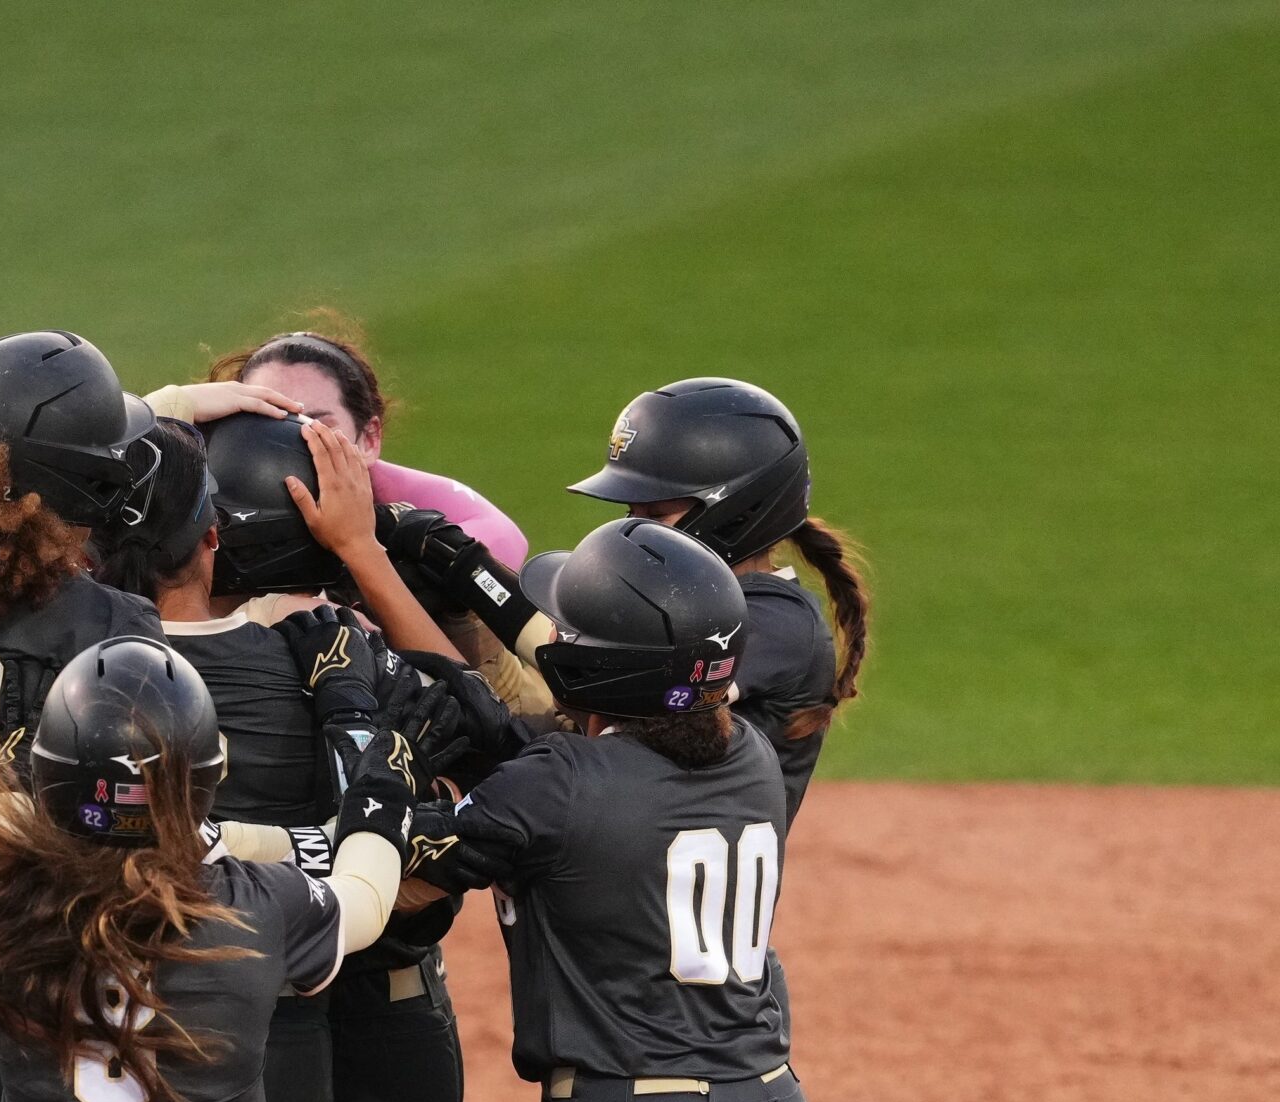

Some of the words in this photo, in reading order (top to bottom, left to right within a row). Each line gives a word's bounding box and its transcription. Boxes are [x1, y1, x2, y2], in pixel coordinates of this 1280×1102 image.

[667, 690, 689, 706] 22
[84, 808, 103, 827] 22
[291, 826, 330, 870] KNI
[666, 821, 778, 985] 00
